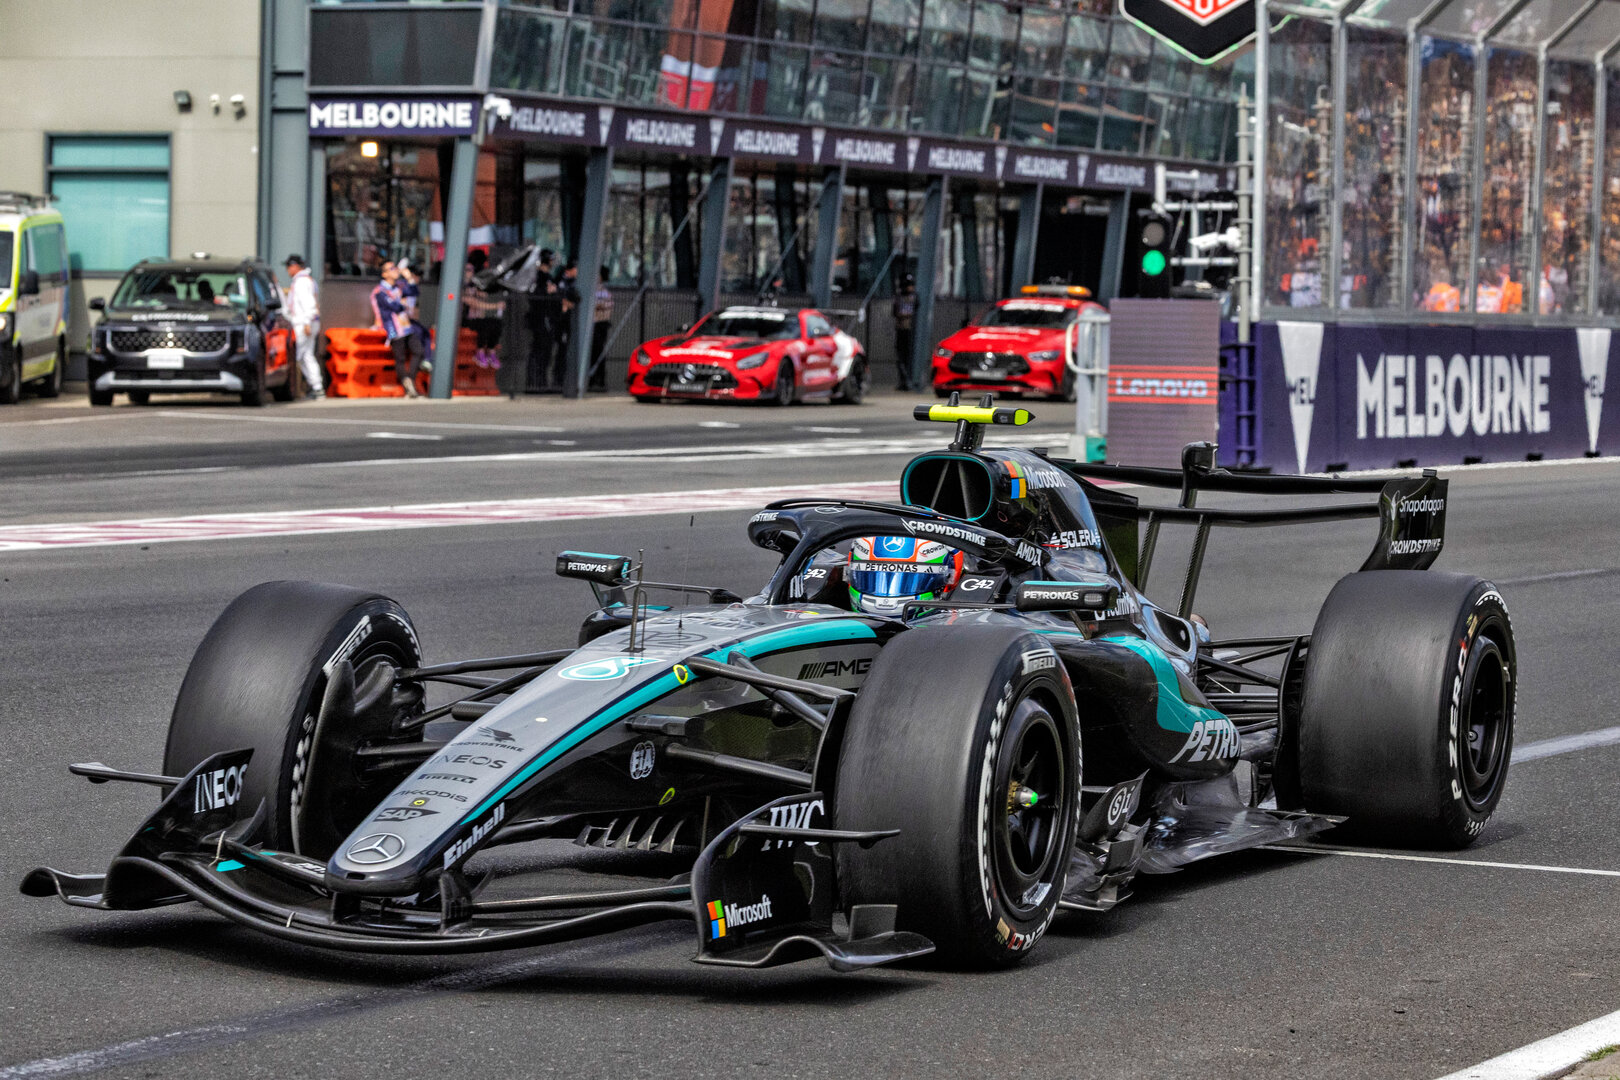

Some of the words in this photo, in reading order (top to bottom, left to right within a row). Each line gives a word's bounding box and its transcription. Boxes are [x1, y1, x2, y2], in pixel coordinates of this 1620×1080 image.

[310, 102, 472, 128] MELBOURNE
[510, 107, 586, 137] MELBOURNE
[625, 118, 696, 147] MELBOURNE
[733, 129, 799, 156] MELBOURNE
[834, 137, 895, 164] MELBOURNE
[929, 146, 985, 173] MELBOURNE
[1014, 154, 1068, 181] MELBOURNE
[1095, 162, 1146, 187] MELBOURNE
[1116, 377, 1207, 397] Lenovo
[1356, 352, 1550, 439] MELBOURNE
[1399, 495, 1444, 517] Snapdragon
[908, 520, 986, 547] CROWDSTRIKE
[1061, 529, 1097, 549] SOLERA
[1390, 539, 1441, 555] CROWDSTRIKE
[567, 562, 607, 573] PETRONAS
[865, 563, 918, 573] PETRONAS
[961, 578, 995, 591] G42
[1023, 591, 1079, 601] PETRONAS
[819, 658, 872, 678] AMG
[1021, 649, 1056, 676] PIRELLI
[450, 741, 524, 752] CROWDSTRIKE
[1168, 719, 1241, 764] PETRO
[430, 754, 507, 769] INEOS
[631, 747, 655, 776] FIA
[194, 763, 248, 814] INEOS
[418, 773, 477, 784] PIRELLI
[377, 808, 423, 820] SAP
[761, 799, 824, 851] IWC
[444, 802, 505, 870] Einhell
[724, 894, 772, 928] Microsoft
